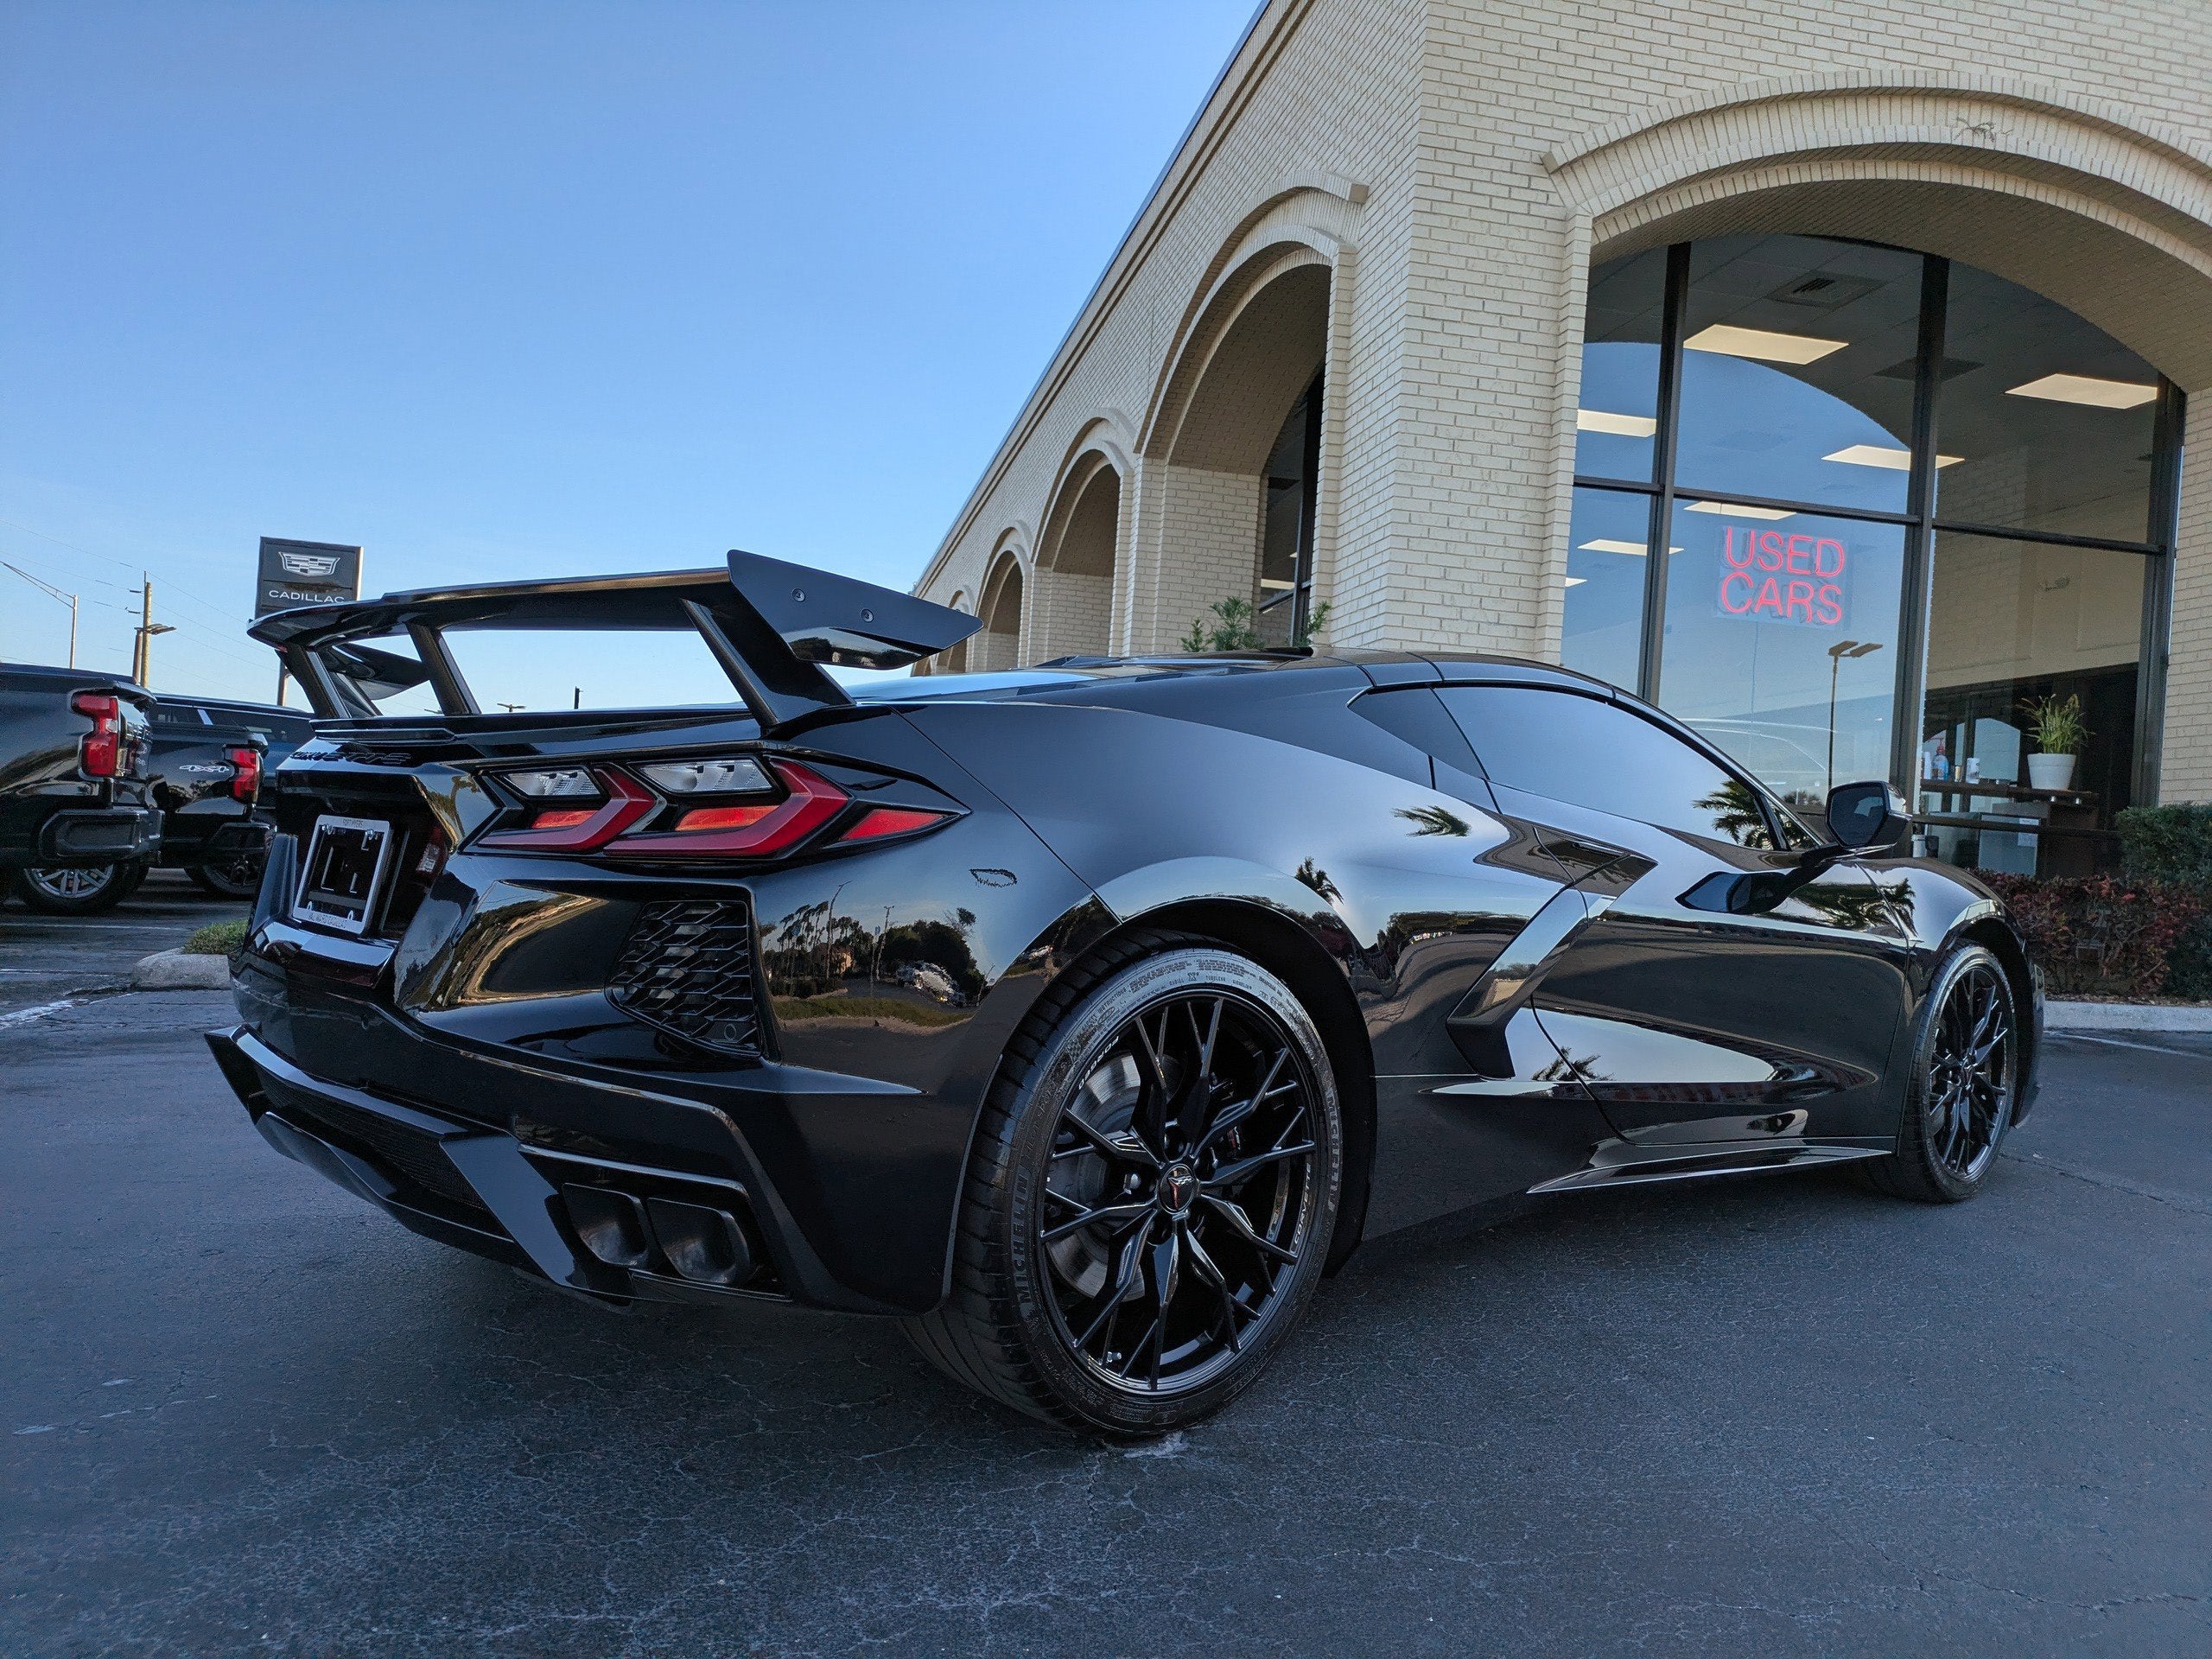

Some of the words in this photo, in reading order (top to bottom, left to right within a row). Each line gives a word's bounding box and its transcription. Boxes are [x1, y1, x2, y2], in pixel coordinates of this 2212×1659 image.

[1726, 525, 1846, 577] USED
[268, 589, 346, 604] CADILLAC
[1721, 571, 1843, 625] CARS
[1295, 1162, 1312, 1244] CORVETTE
[1012, 1173, 1032, 1303] MICHELIN
